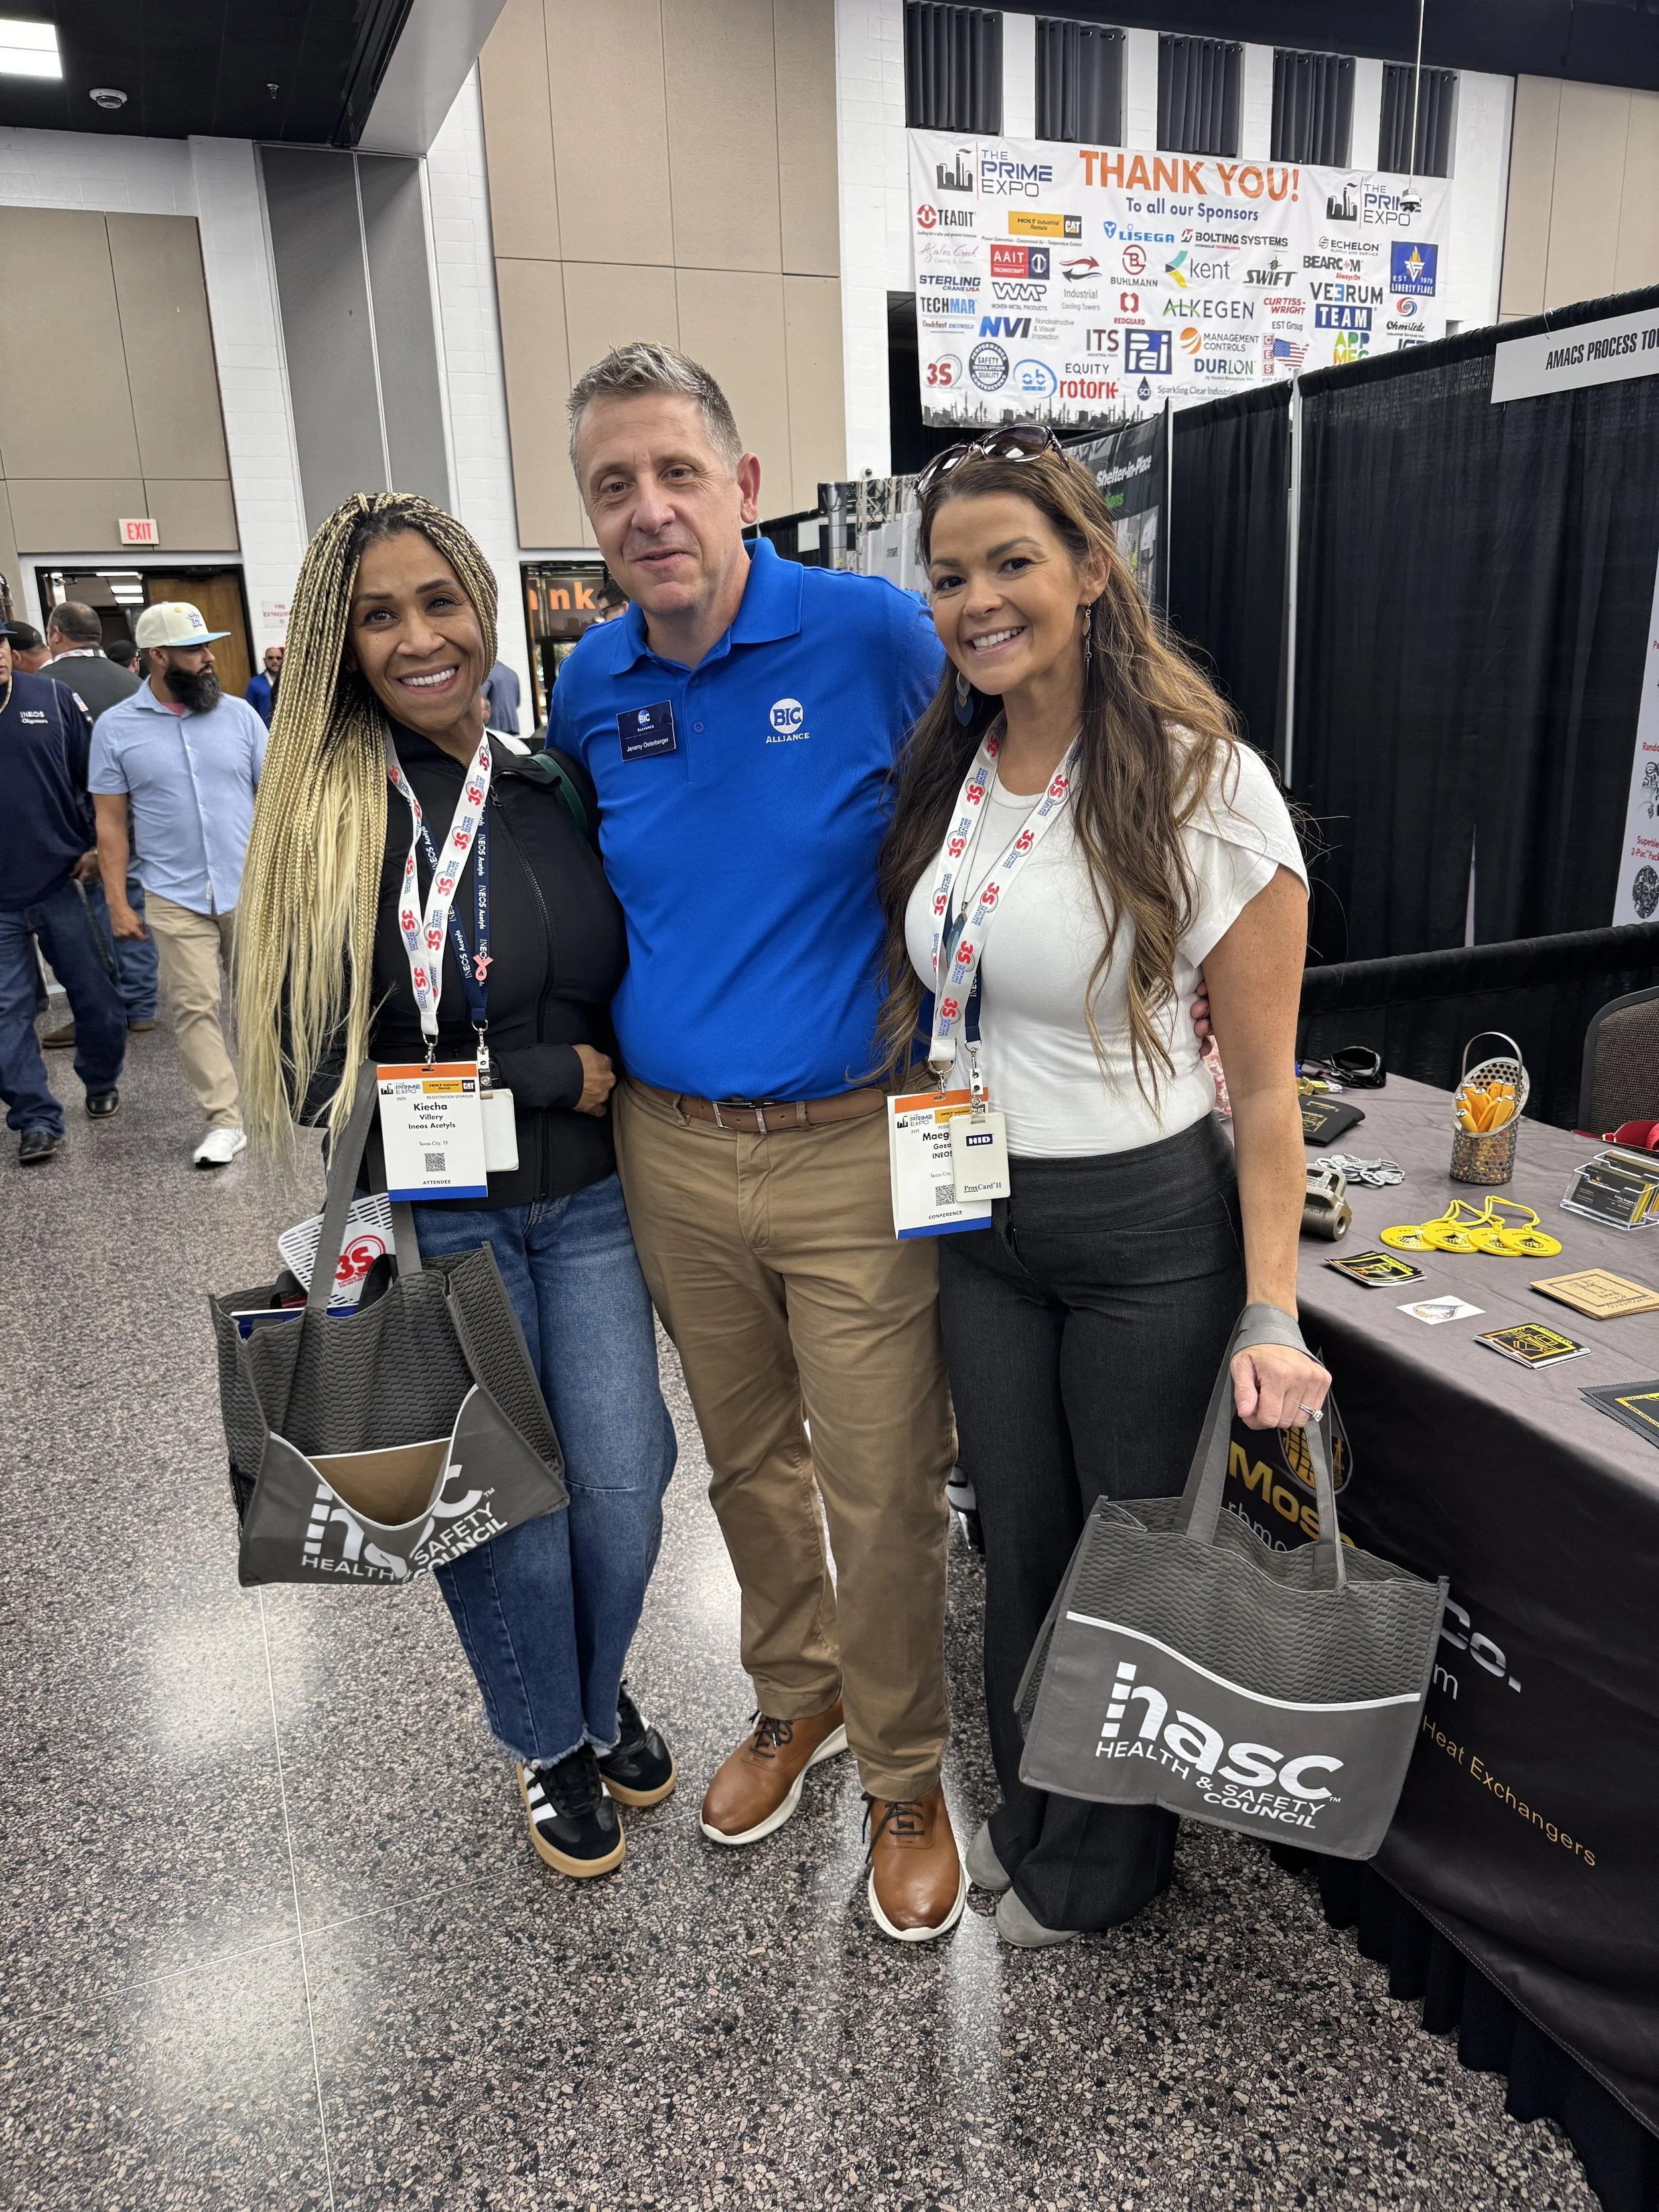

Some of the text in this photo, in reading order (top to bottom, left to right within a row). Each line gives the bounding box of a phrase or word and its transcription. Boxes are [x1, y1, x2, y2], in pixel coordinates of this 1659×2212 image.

[981, 150, 1009, 160] THE
[981, 161, 1052, 182] PRIME
[1079, 150, 1299, 202] THANK YOU!
[982, 179, 1039, 197] EXPO
[1364, 184, 1386, 193] THE
[938, 209, 974, 227] TEADIT
[1126, 197, 1259, 223] To all our Sponsors
[1364, 210, 1410, 226] EXPO
[1065, 220, 1081, 234] CAT
[1119, 231, 1175, 243] LISEGA
[1196, 232, 1288, 247] BOLTING SYSTEMS
[1331, 240, 1379, 252] ECHELON
[995, 252, 1025, 263] AAIT
[1190, 259, 1230, 279] kent
[1336, 273, 1352, 281] Always
[919, 275, 981, 286] STERLING
[1111, 277, 1158, 287] BUHLMANN
[1242, 270, 1298, 287] SWIFT
[1064, 289, 1098, 299] Industrial
[1392, 284, 1433, 294] LIBERTY FLARE
[920, 297, 975, 315] TECHMAR
[1062, 303, 1080, 311] Cooling
[1163, 299, 1254, 319] ALKEGEN
[1287, 322, 1303, 331] Group
[1320, 307, 1367, 328] TEAM
[1387, 321, 1425, 332] Ohmstede
[979, 316, 1031, 338] NVI
[1086, 329, 1119, 352] ITS
[1204, 333, 1260, 343] MANAGEMENT
[1204, 342, 1246, 352] CONTROLS
[1334, 331, 1370, 349] APP
[972, 343, 1007, 361] PERFORMANCE
[1545, 344, 1584, 370] AMACS
[1587, 332, 1638, 362] PROCESS
[926, 363, 952, 386] 3S
[1065, 363, 1109, 374] EQUITY
[1195, 358, 1254, 374] DURLON
[1060, 378, 1118, 399] rotork
[1158, 386, 1188, 395] Sparkling
[1096, 455, 1152, 488] Shelter-in-Place
[127, 523, 151, 540] EXIT
[639, 713, 650, 723] BIC
[773, 707, 801, 726] BIC
[626, 737, 669, 753] Jeremy Osterberger
[766, 733, 810, 743] ALLIANCE
[967, 784, 983, 806] 3S
[1050, 774, 1068, 798] 3S
[949, 838, 965, 858] 3S
[1015, 830, 1035, 850] 3S
[982, 882, 1000, 905] 3S
[455, 930, 465, 951] Acetyls
[958, 940, 974, 965] 3S
[460, 953, 472, 978] INEOS
[413, 1102, 447, 1111] Kiecha
[922, 1132, 950, 1142] Maeg
[929, 1211, 962, 1219] CONFERENCE
[335, 1246, 374, 1280] 3S
[301, 1501, 490, 1582] HEALTH SAFETY
[413, 1516, 508, 1581] COUNCIL
[1100, 1661, 1344, 1801] hasc
[1095, 1741, 1326, 1816] HEALTH & SAFETY
[1422, 1714, 1596, 1866] Heat Exchangers
[1203, 1792, 1317, 1829] COUNCIL
